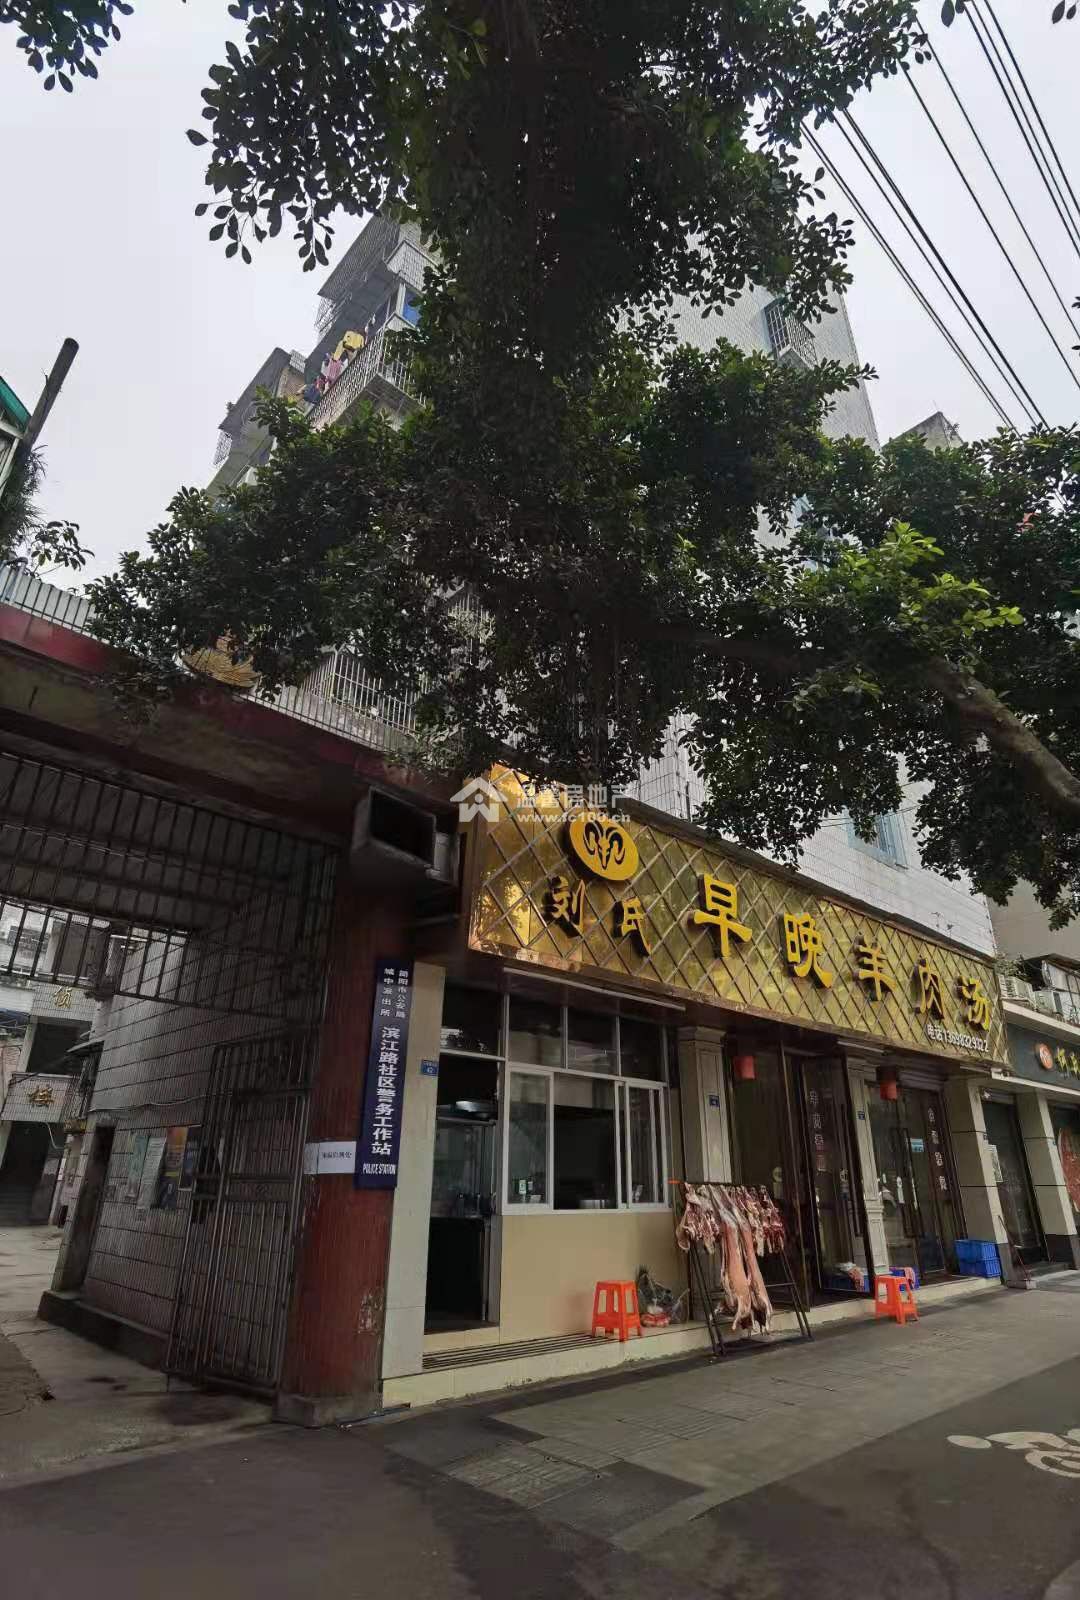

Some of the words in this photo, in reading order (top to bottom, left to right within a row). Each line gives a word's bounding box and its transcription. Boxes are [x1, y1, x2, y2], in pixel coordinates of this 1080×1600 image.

[693, 873, 991, 1031] 早晚羊肉汤
[371, 1026, 400, 1155] 滨江路社区警务工作站
[362, 1163, 379, 1175] POLICE
[379, 1164, 397, 1175] STATION
